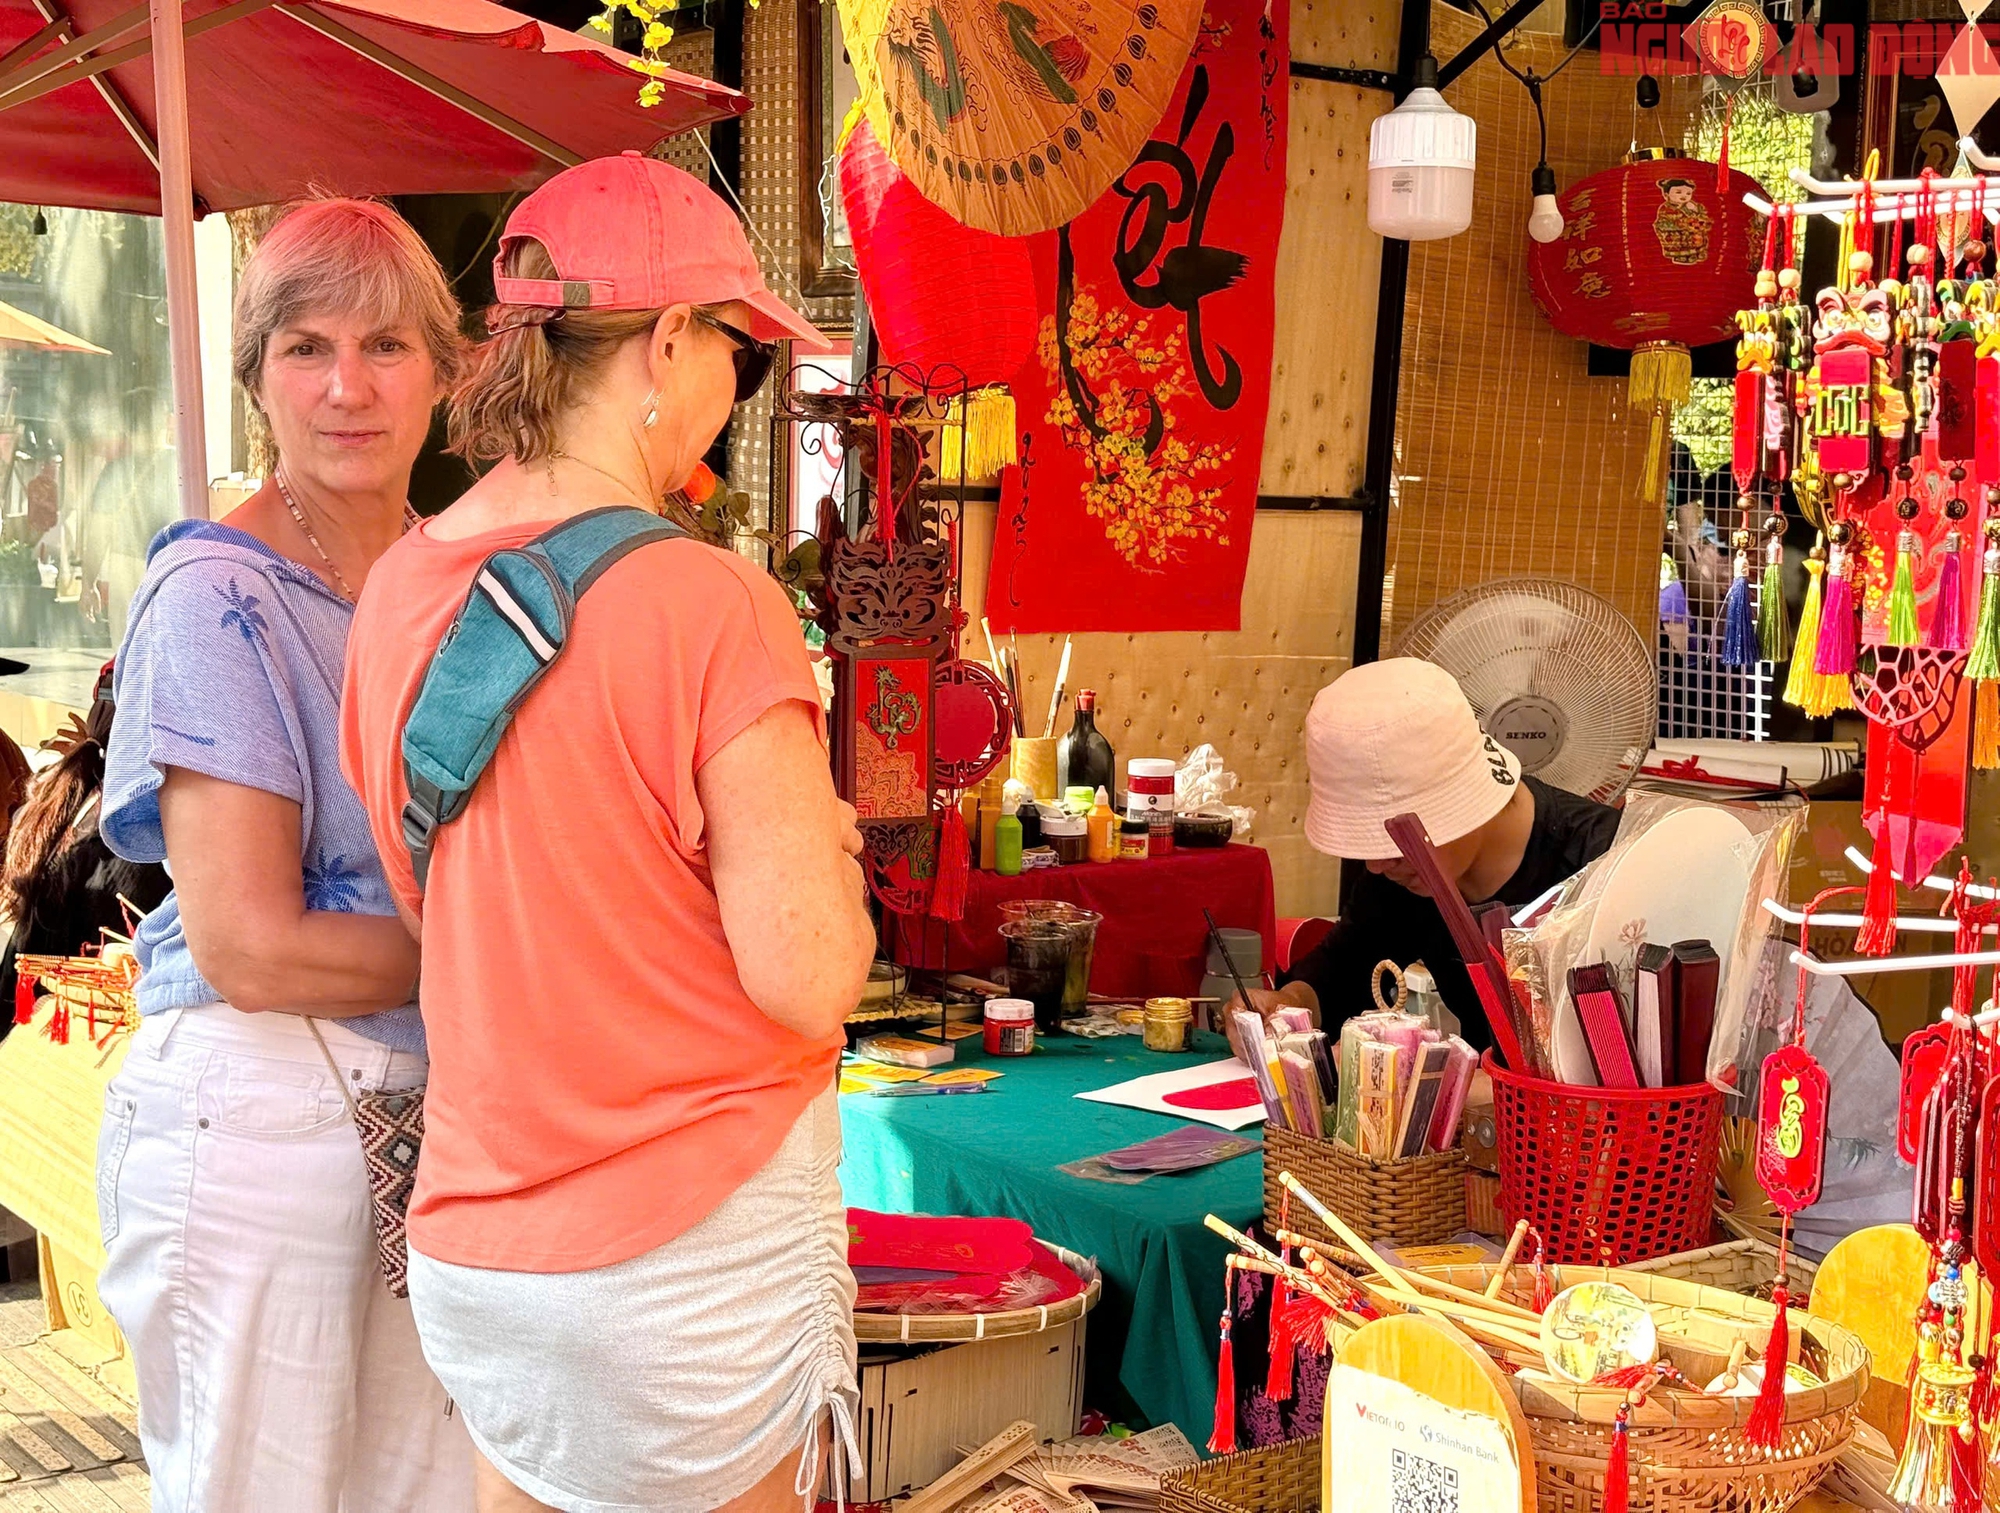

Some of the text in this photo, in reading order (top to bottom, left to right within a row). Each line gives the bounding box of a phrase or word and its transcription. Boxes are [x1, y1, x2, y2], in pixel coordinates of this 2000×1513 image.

[1505, 731, 1547, 740] SENKO
[1435, 1432, 1500, 1464] Shinhan Bank
